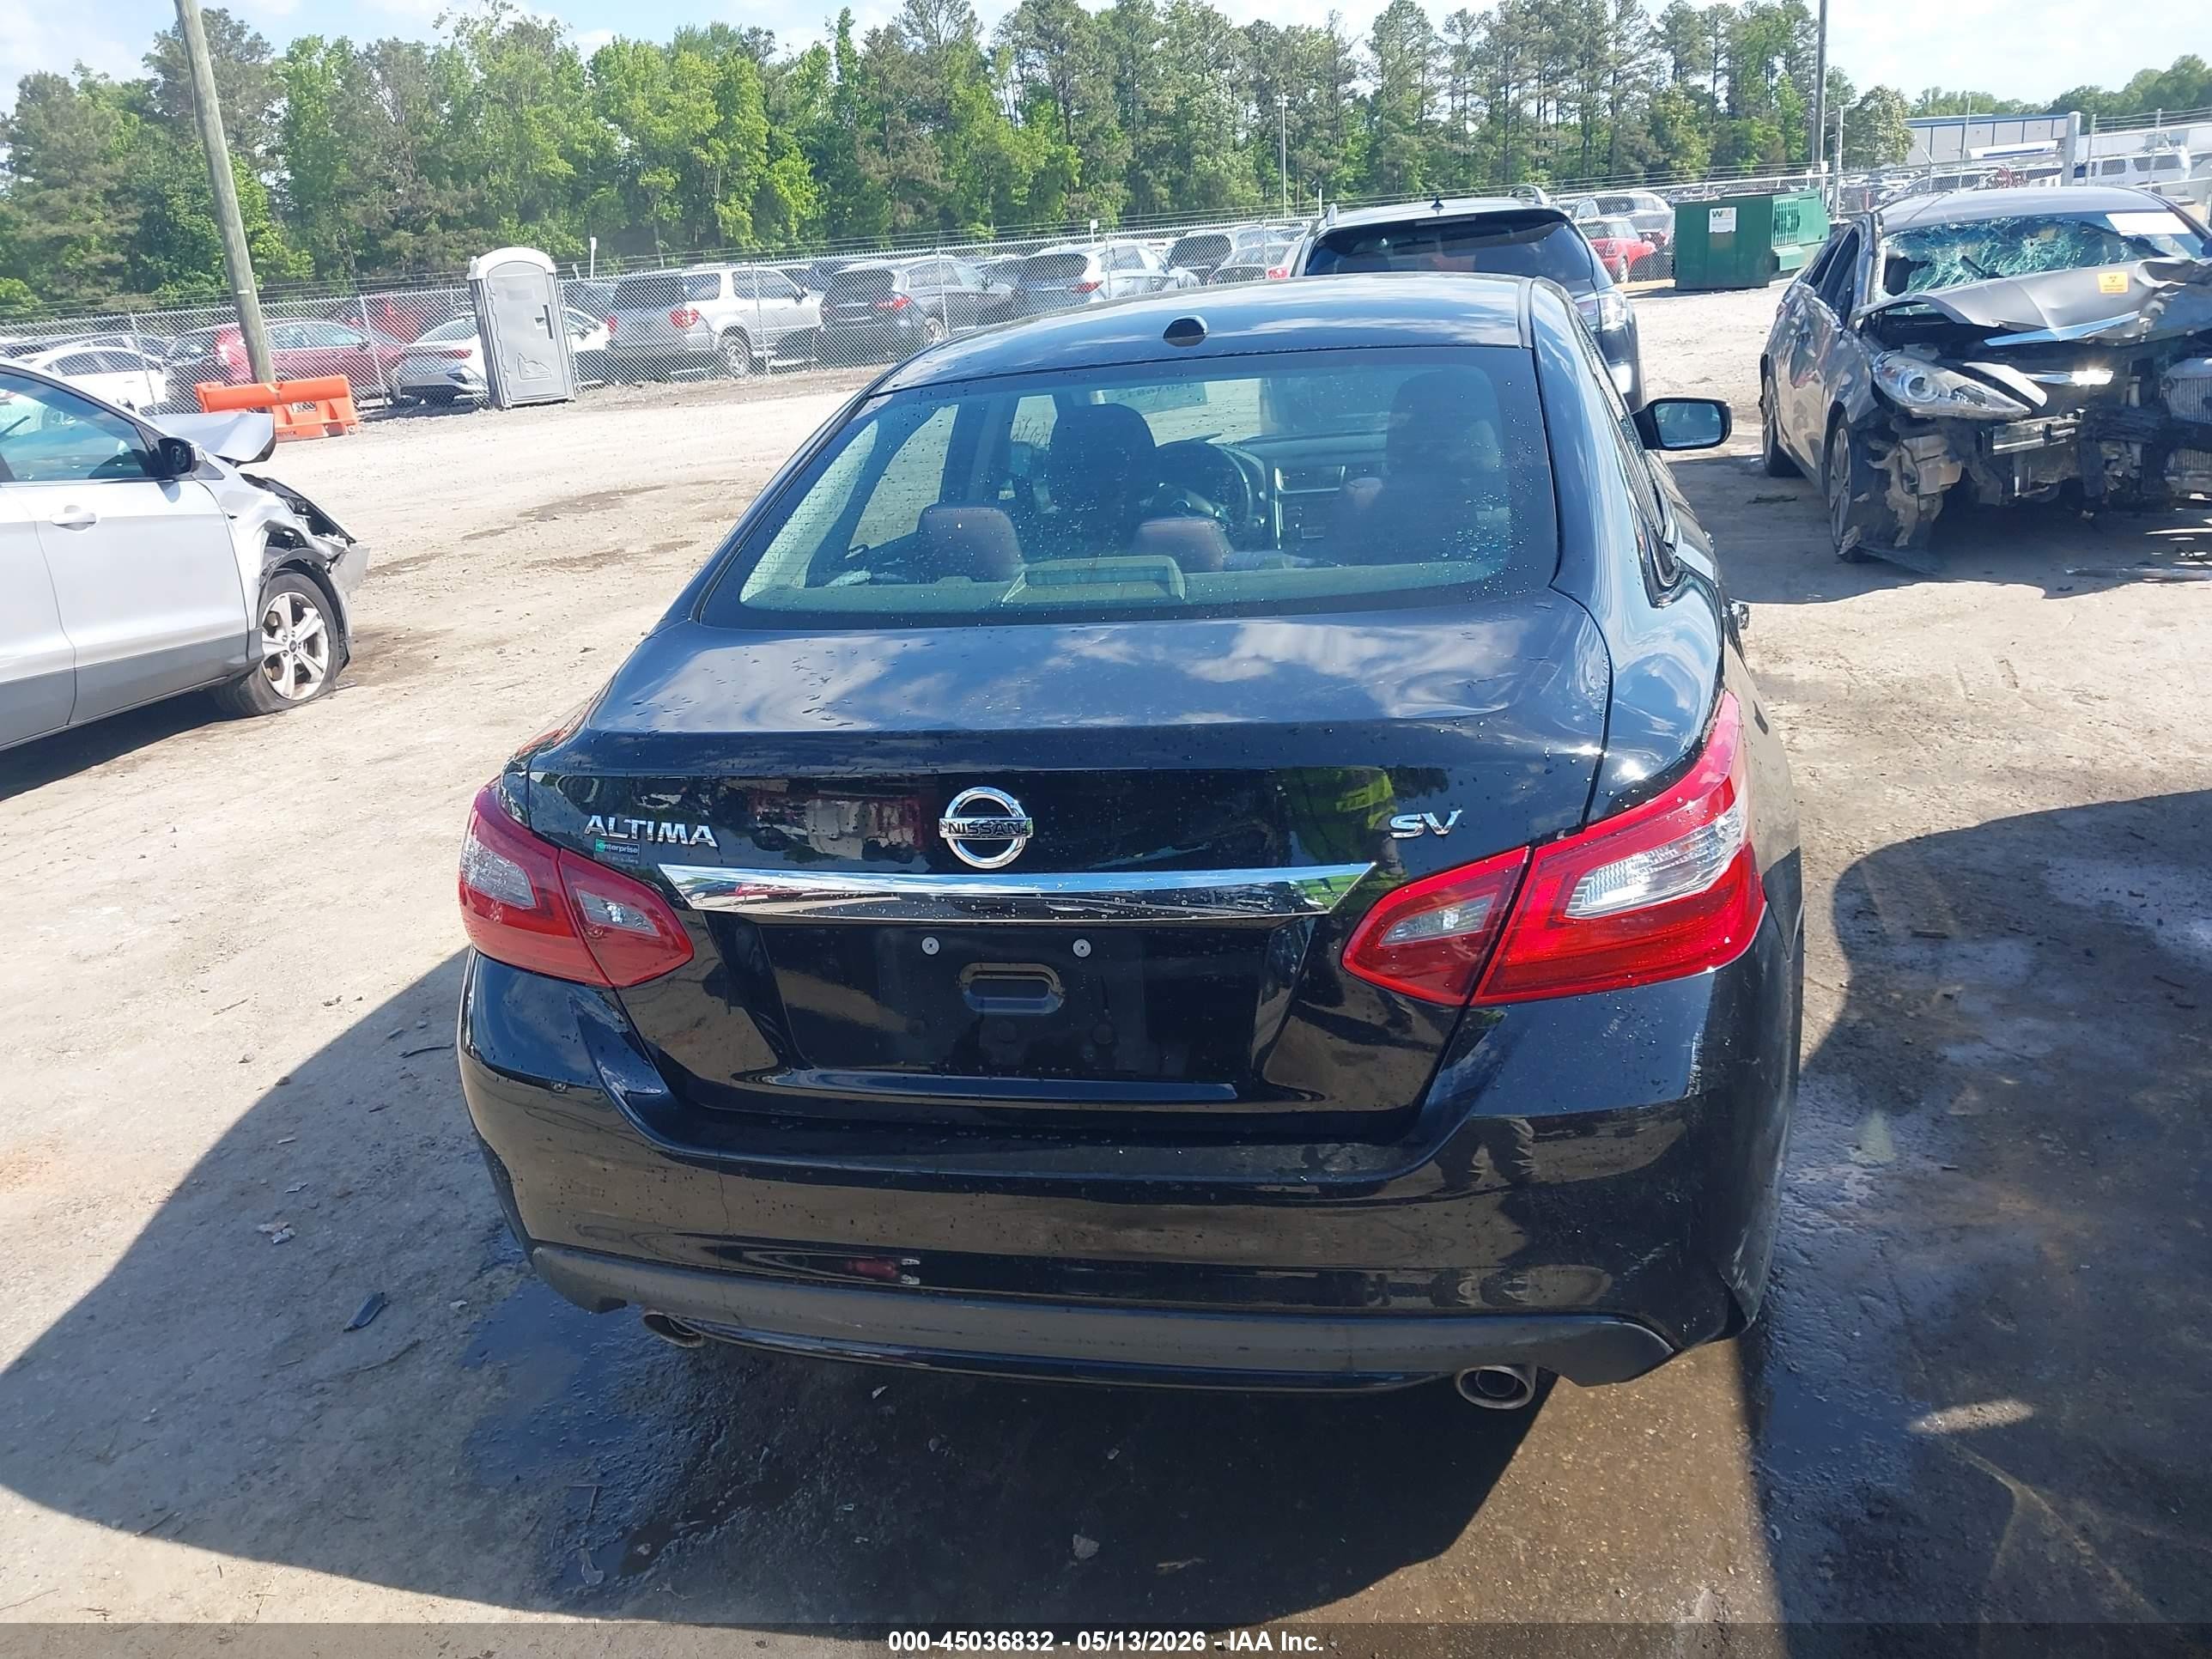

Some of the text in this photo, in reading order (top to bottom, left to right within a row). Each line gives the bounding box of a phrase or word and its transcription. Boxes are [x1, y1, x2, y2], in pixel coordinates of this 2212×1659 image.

[584, 814, 720, 848] ALTIMA
[947, 822, 1021, 836] NISSAN
[1389, 809, 1463, 840] SV
[595, 841, 639, 854] enterprise
